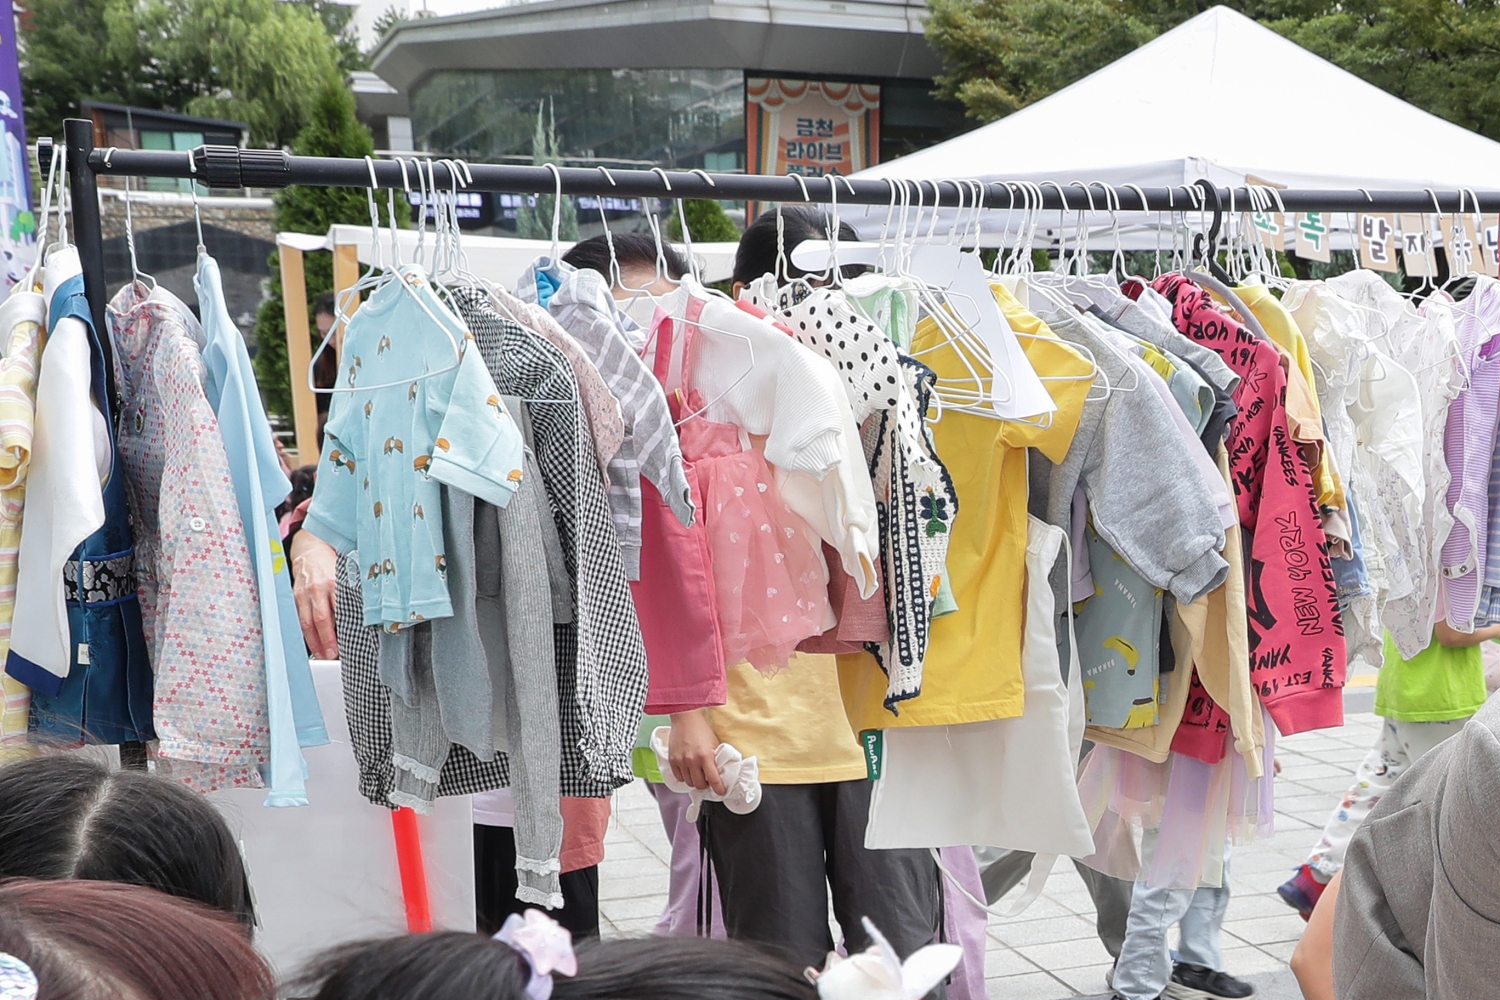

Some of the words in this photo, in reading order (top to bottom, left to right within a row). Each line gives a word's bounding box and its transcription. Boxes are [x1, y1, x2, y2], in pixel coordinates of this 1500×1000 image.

[796, 117, 835, 139] 금천
[785, 141, 843, 161] 라이브
[1245, 396, 1266, 423] NEW
[1272, 425, 1300, 488] YANKEES
[1275, 510, 1313, 582] YORK
[1291, 587, 1324, 636] NEW
